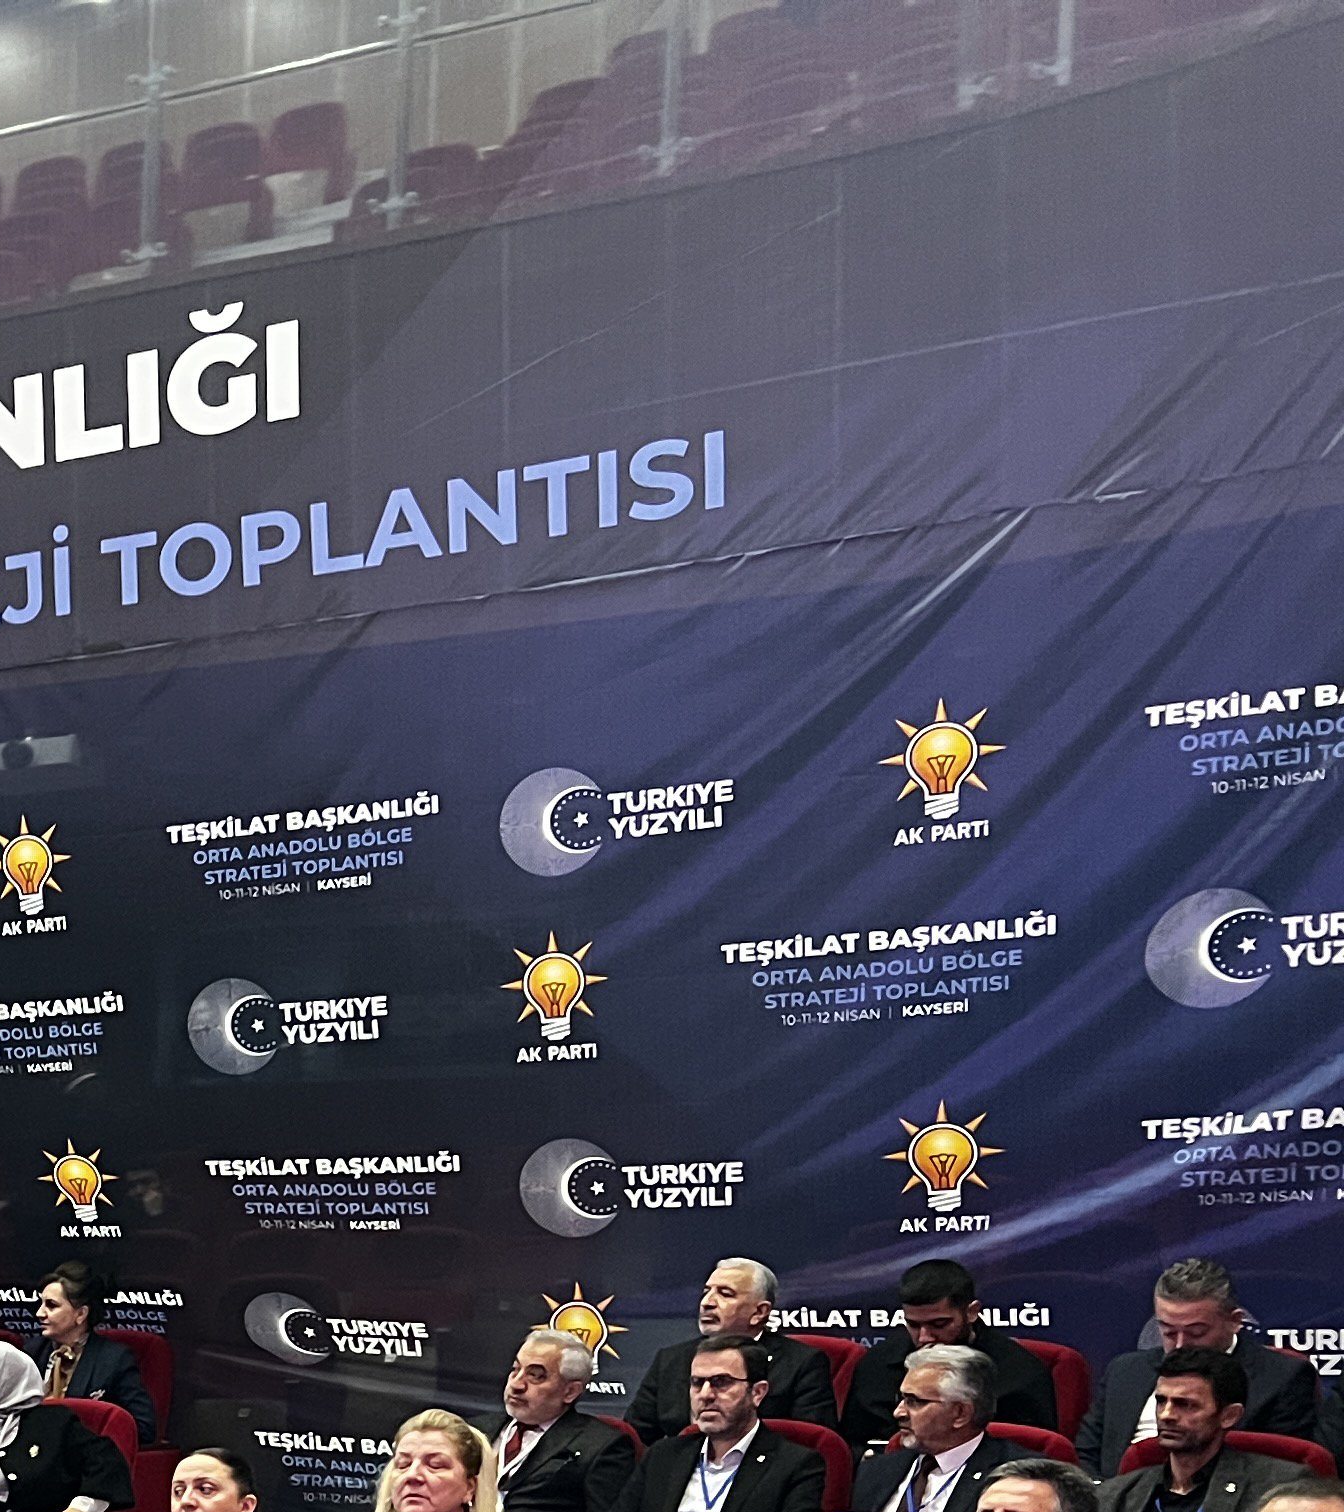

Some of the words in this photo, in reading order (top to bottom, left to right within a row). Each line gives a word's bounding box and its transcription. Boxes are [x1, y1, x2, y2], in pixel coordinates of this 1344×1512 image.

[100, 429, 727, 606] TOPLANTISI
[1145, 688, 1305, 728] TEŞKİLAT
[1180, 729, 1249, 751] ORTA
[1192, 742, 1310, 775] STRATEJİ
[166, 814, 280, 846] TEŞKİLAT
[286, 791, 438, 831] BAŞKANLIĞI
[194, 847, 243, 864] ORTA
[248, 836, 341, 859] ANADOLU
[348, 827, 412, 848] BÖLGE
[893, 826, 924, 847] AK
[205, 859, 286, 884] STRATEJİ
[292, 851, 403, 875] TOPLANTISI
[1, 920, 23, 937] AK
[721, 933, 860, 966] TEŞKİLAT
[869, 910, 1056, 952] BAŞKANLIĞI
[752, 968, 812, 986] ORTA
[819, 957, 933, 981] ANADOLU
[942, 949, 1022, 971] BÖLGE
[765, 983, 865, 1009] STRATEJİ
[873, 975, 1009, 1000] TOPLANTISI
[781, 1012, 830, 1025] 10-11-12
[834, 1008, 880, 1022] NİSAN
[903, 998, 968, 1017] KAYSERİ
[48, 1022, 104, 1039] BÖLGE
[3, 1042, 98, 1060] TOPLANTISI
[516, 1046, 542, 1063] AK
[1141, 1109, 1294, 1144] TEŞKİLAT
[1173, 1145, 1236, 1165] ORTA
[1243, 1139, 1343, 1160] ANADO
[205, 1157, 309, 1180] TEŞKİLAT
[316, 1152, 460, 1179] BAŞKANLIĞI
[1179, 1162, 1297, 1188] STRATEJİ
[233, 1184, 278, 1196] ORTA
[283, 1184, 369, 1196] ANADOLU
[375, 1182, 436, 1195] BÖLGE
[245, 1199, 320, 1214] STRATEJİ
[325, 1202, 429, 1214] TOPLANTISI
[60, 1225, 80, 1238] AK
[899, 1217, 928, 1233] AK
[253, 1431, 355, 1452] TEŞKİLAT
[281, 1454, 327, 1469] ORTA
